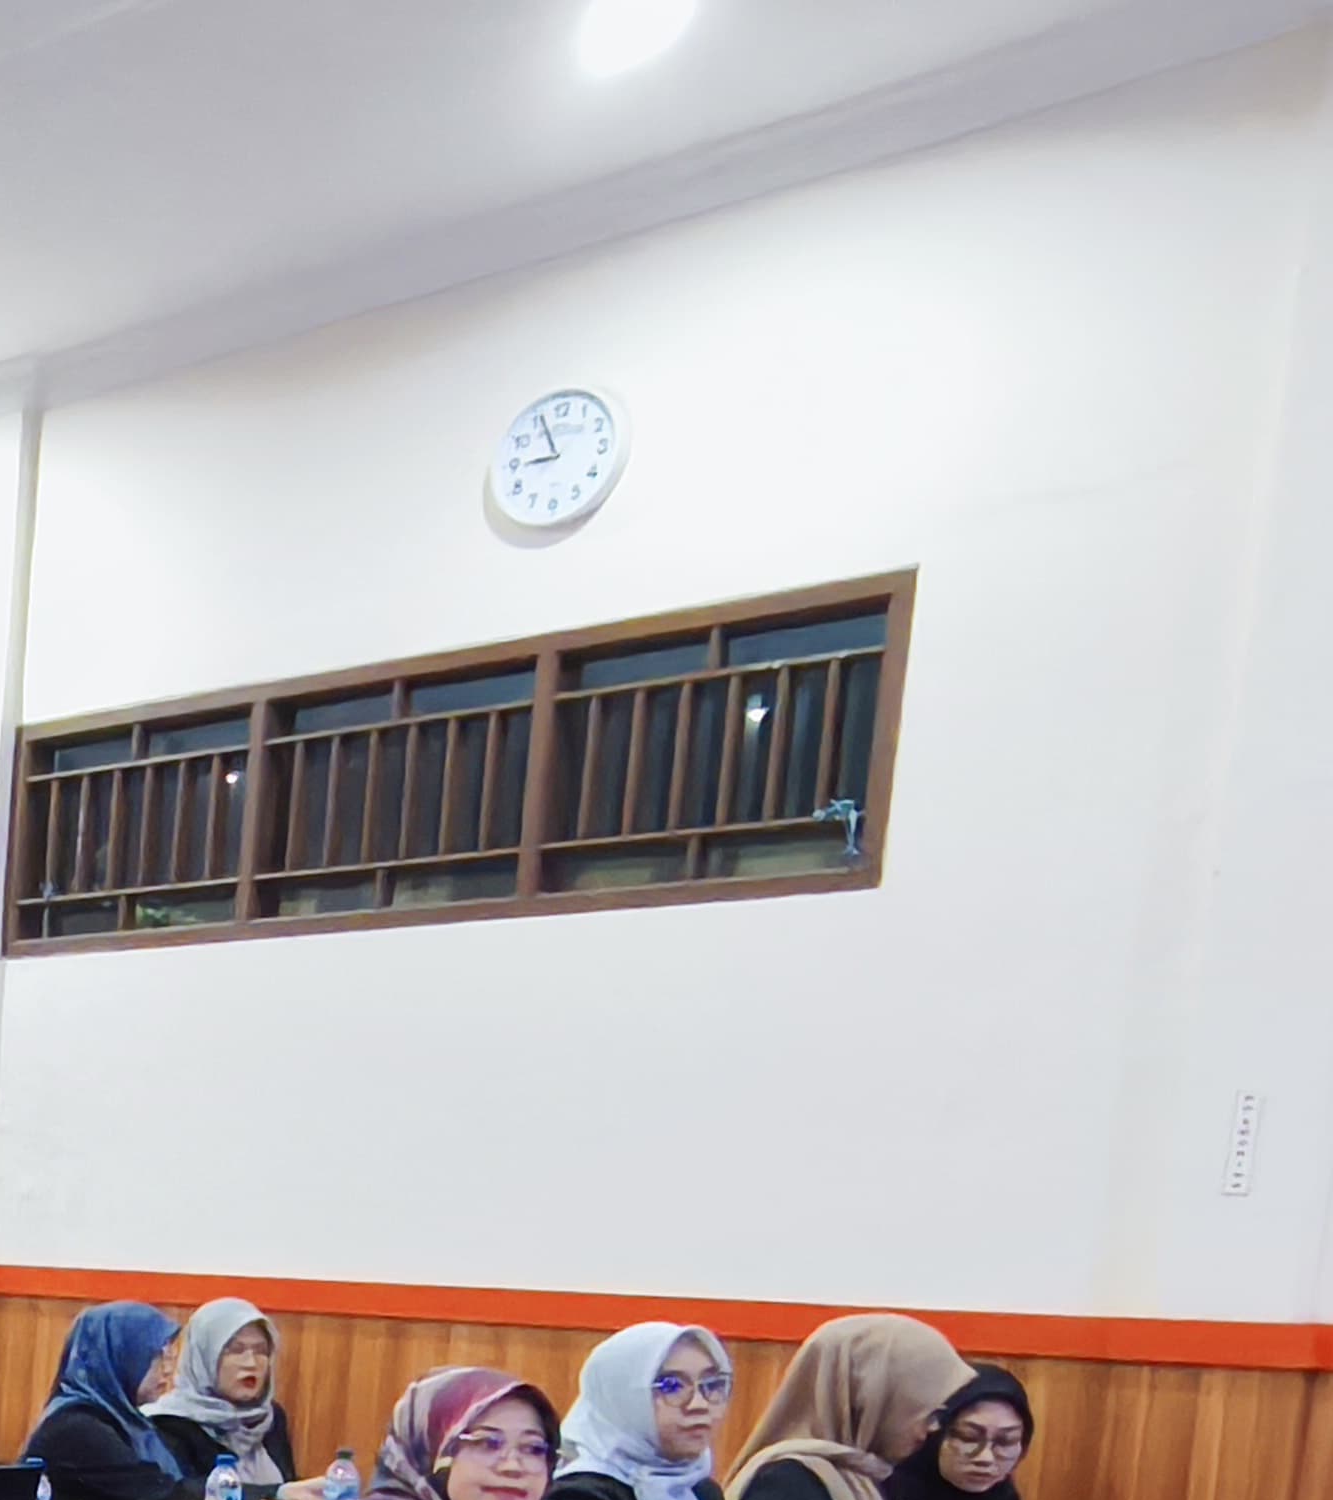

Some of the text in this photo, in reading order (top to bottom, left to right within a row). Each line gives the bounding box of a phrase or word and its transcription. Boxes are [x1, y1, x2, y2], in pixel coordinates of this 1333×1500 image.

[594, 418, 604, 432] 2
[597, 438, 608, 454] 3
[509, 457, 520, 471] 9
